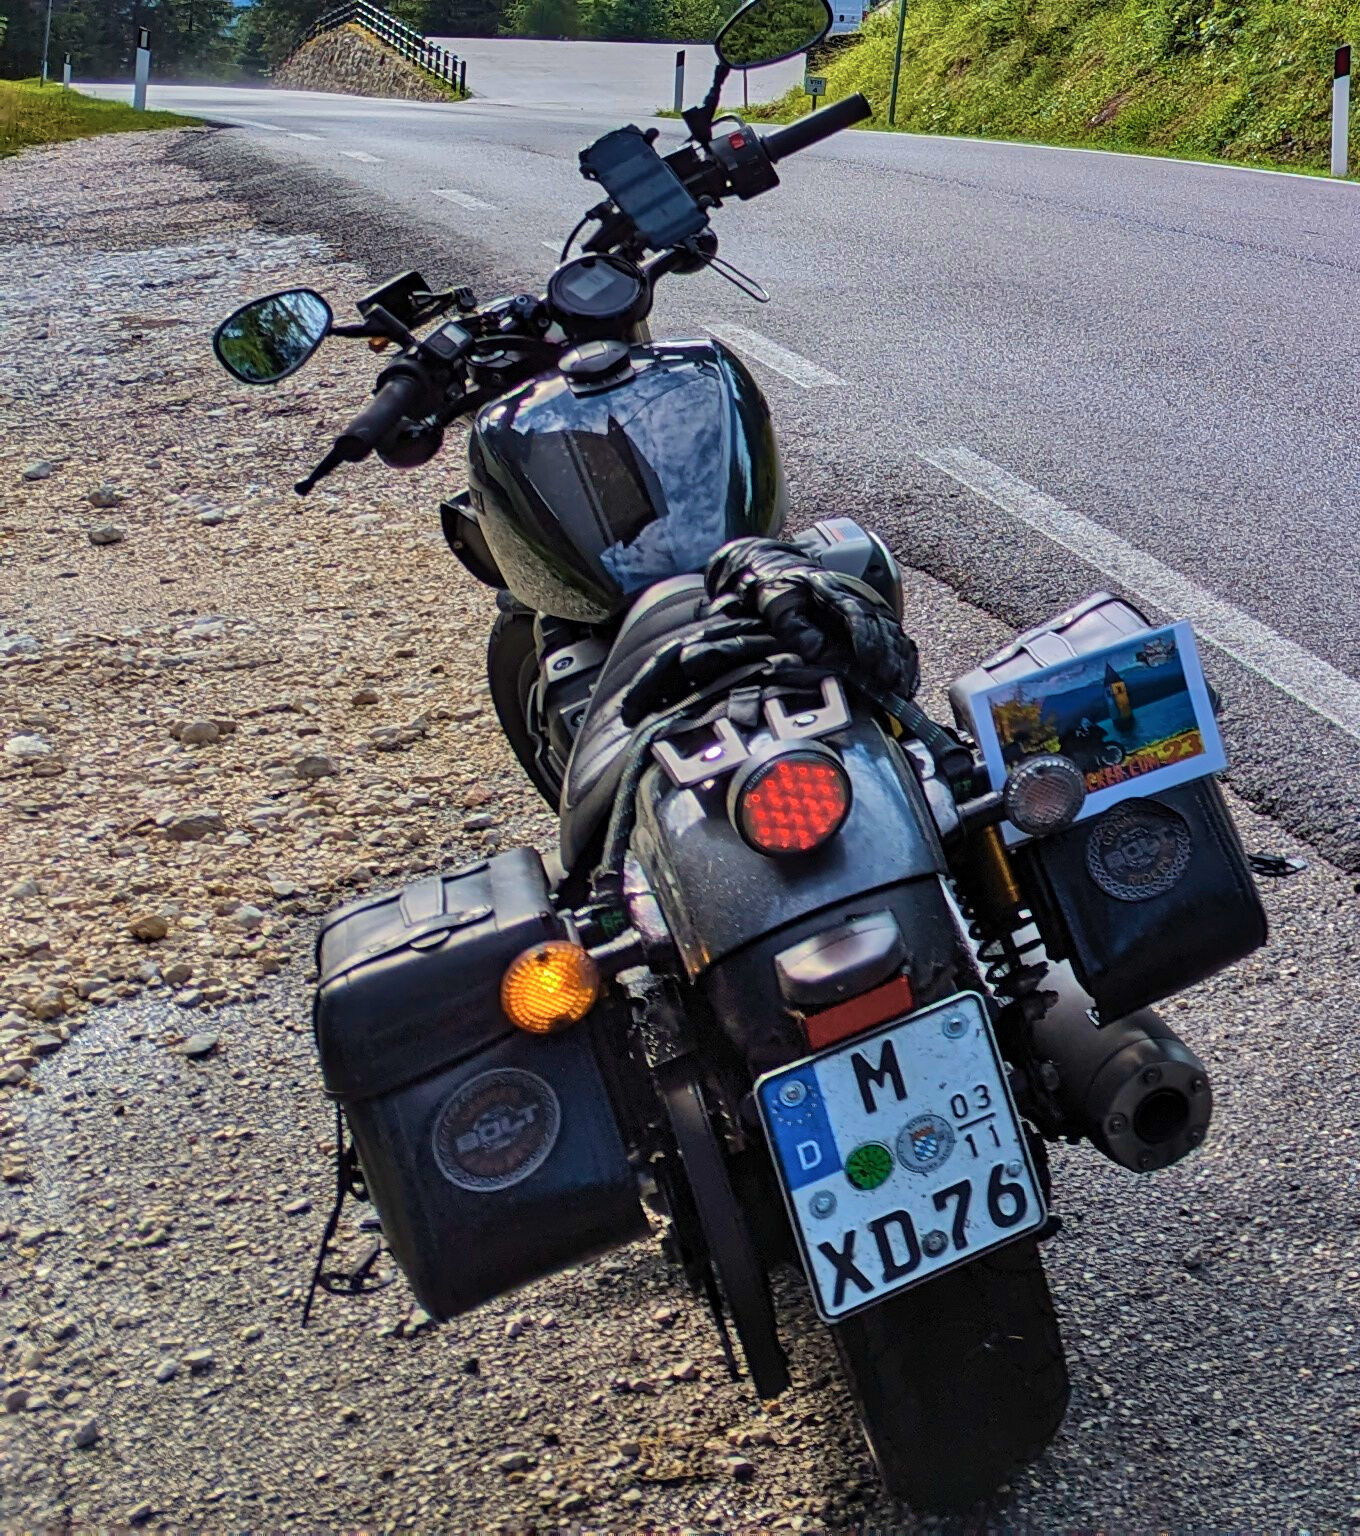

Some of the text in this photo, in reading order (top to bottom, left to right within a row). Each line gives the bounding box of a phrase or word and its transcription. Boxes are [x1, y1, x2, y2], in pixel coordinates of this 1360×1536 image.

[1163, 734, 1203, 763] 23
[850, 1039, 908, 1115] M
[950, 1084, 992, 1120] 03
[796, 1139, 823, 1171] D
[964, 1123, 1002, 1159] 11
[817, 1162, 1028, 1307] XD 76
